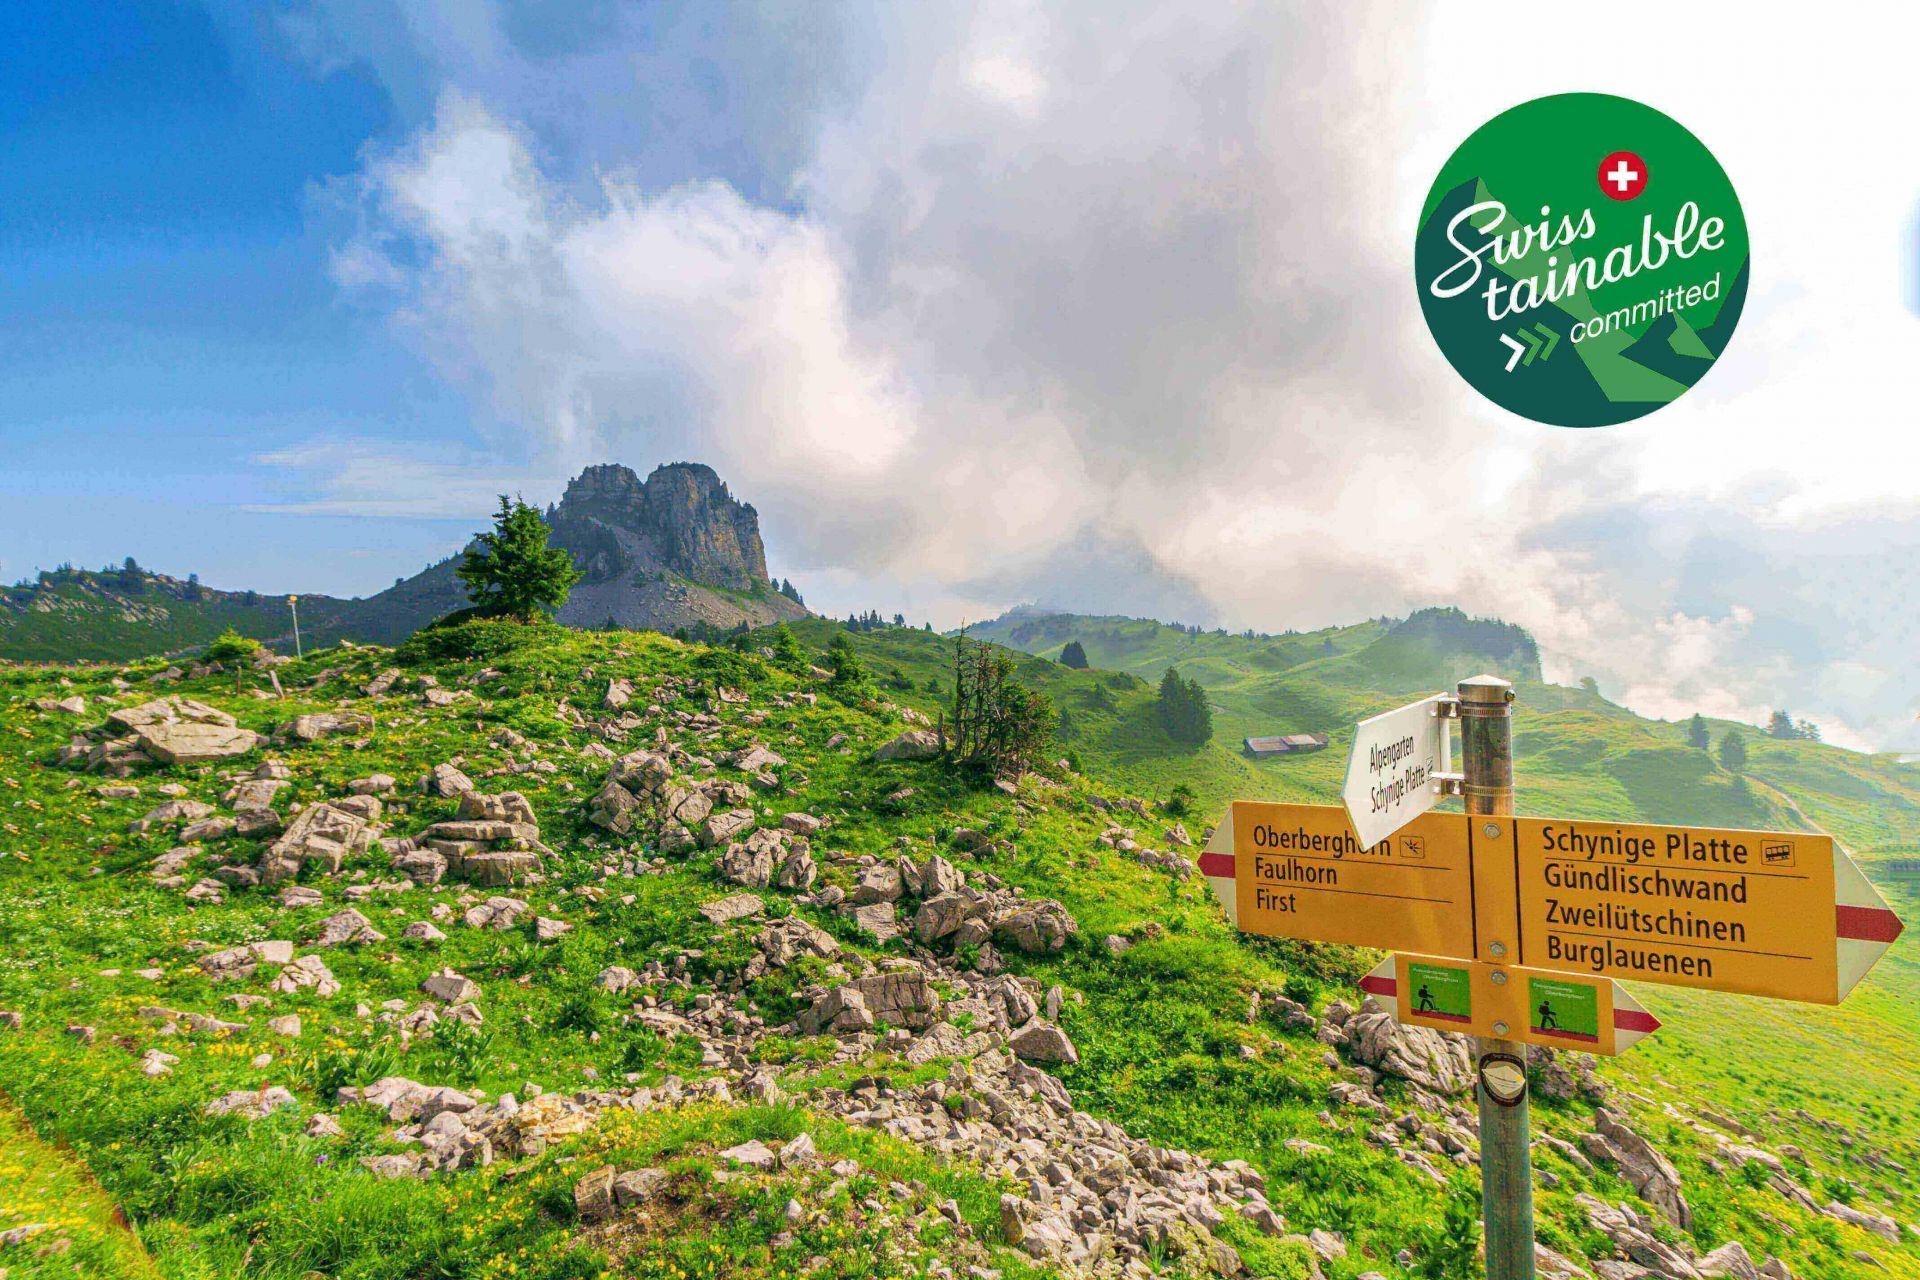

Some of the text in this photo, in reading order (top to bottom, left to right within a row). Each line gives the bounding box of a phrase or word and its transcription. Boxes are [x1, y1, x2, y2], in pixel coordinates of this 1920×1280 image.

[1369, 735, 1414, 777] Alpengarten
[1371, 765, 1425, 813] Schynige Platte
[1542, 826, 1748, 865] Schynige Platte
[1255, 857, 1337, 885] Faulhorn
[1544, 863, 1748, 904] Gündlischwand
[1256, 888, 1296, 913] First
[1545, 899, 1746, 943] Zweilütschinen
[1548, 936, 1712, 977] Burglauenen
